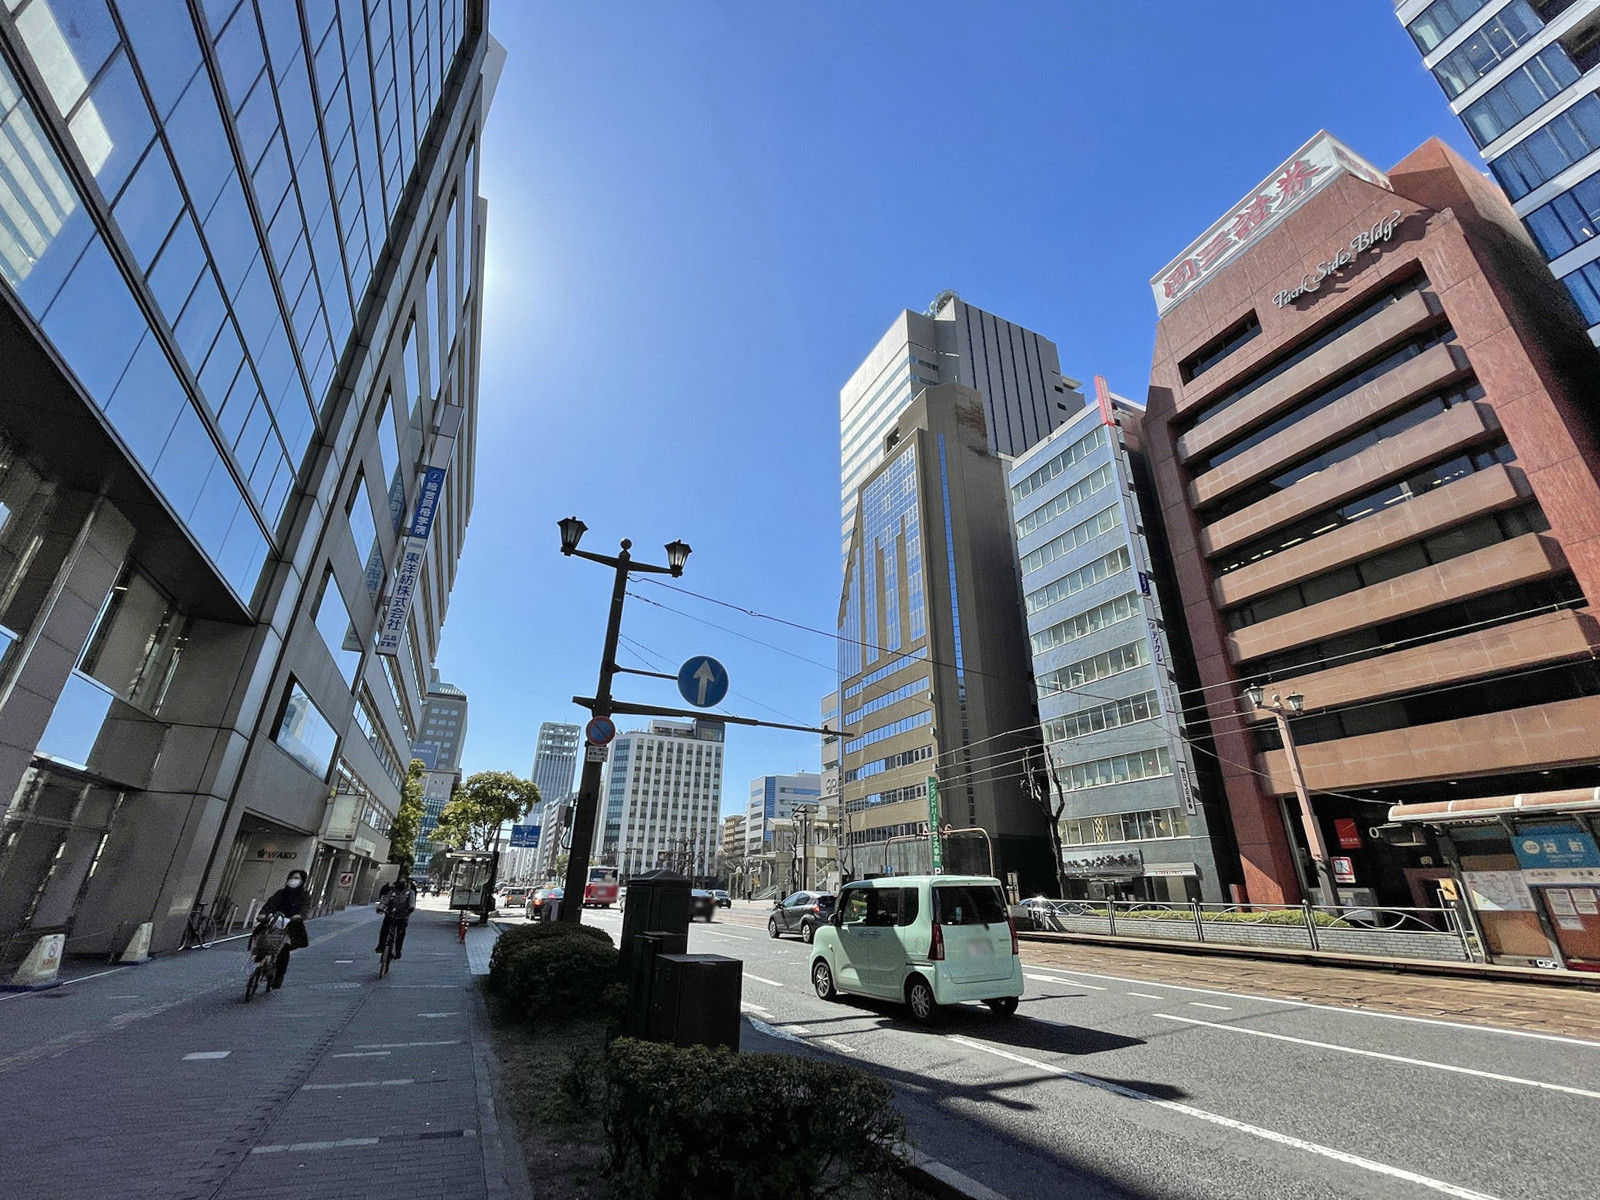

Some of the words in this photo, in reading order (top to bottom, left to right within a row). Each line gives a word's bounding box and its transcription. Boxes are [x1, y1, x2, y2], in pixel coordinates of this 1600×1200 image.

[1272, 274, 1319, 309] Park
[1313, 247, 1352, 283] Side
[386, 551, 421, 631] 東洋紡株式会社
[268, 851, 297, 860] WAKO
